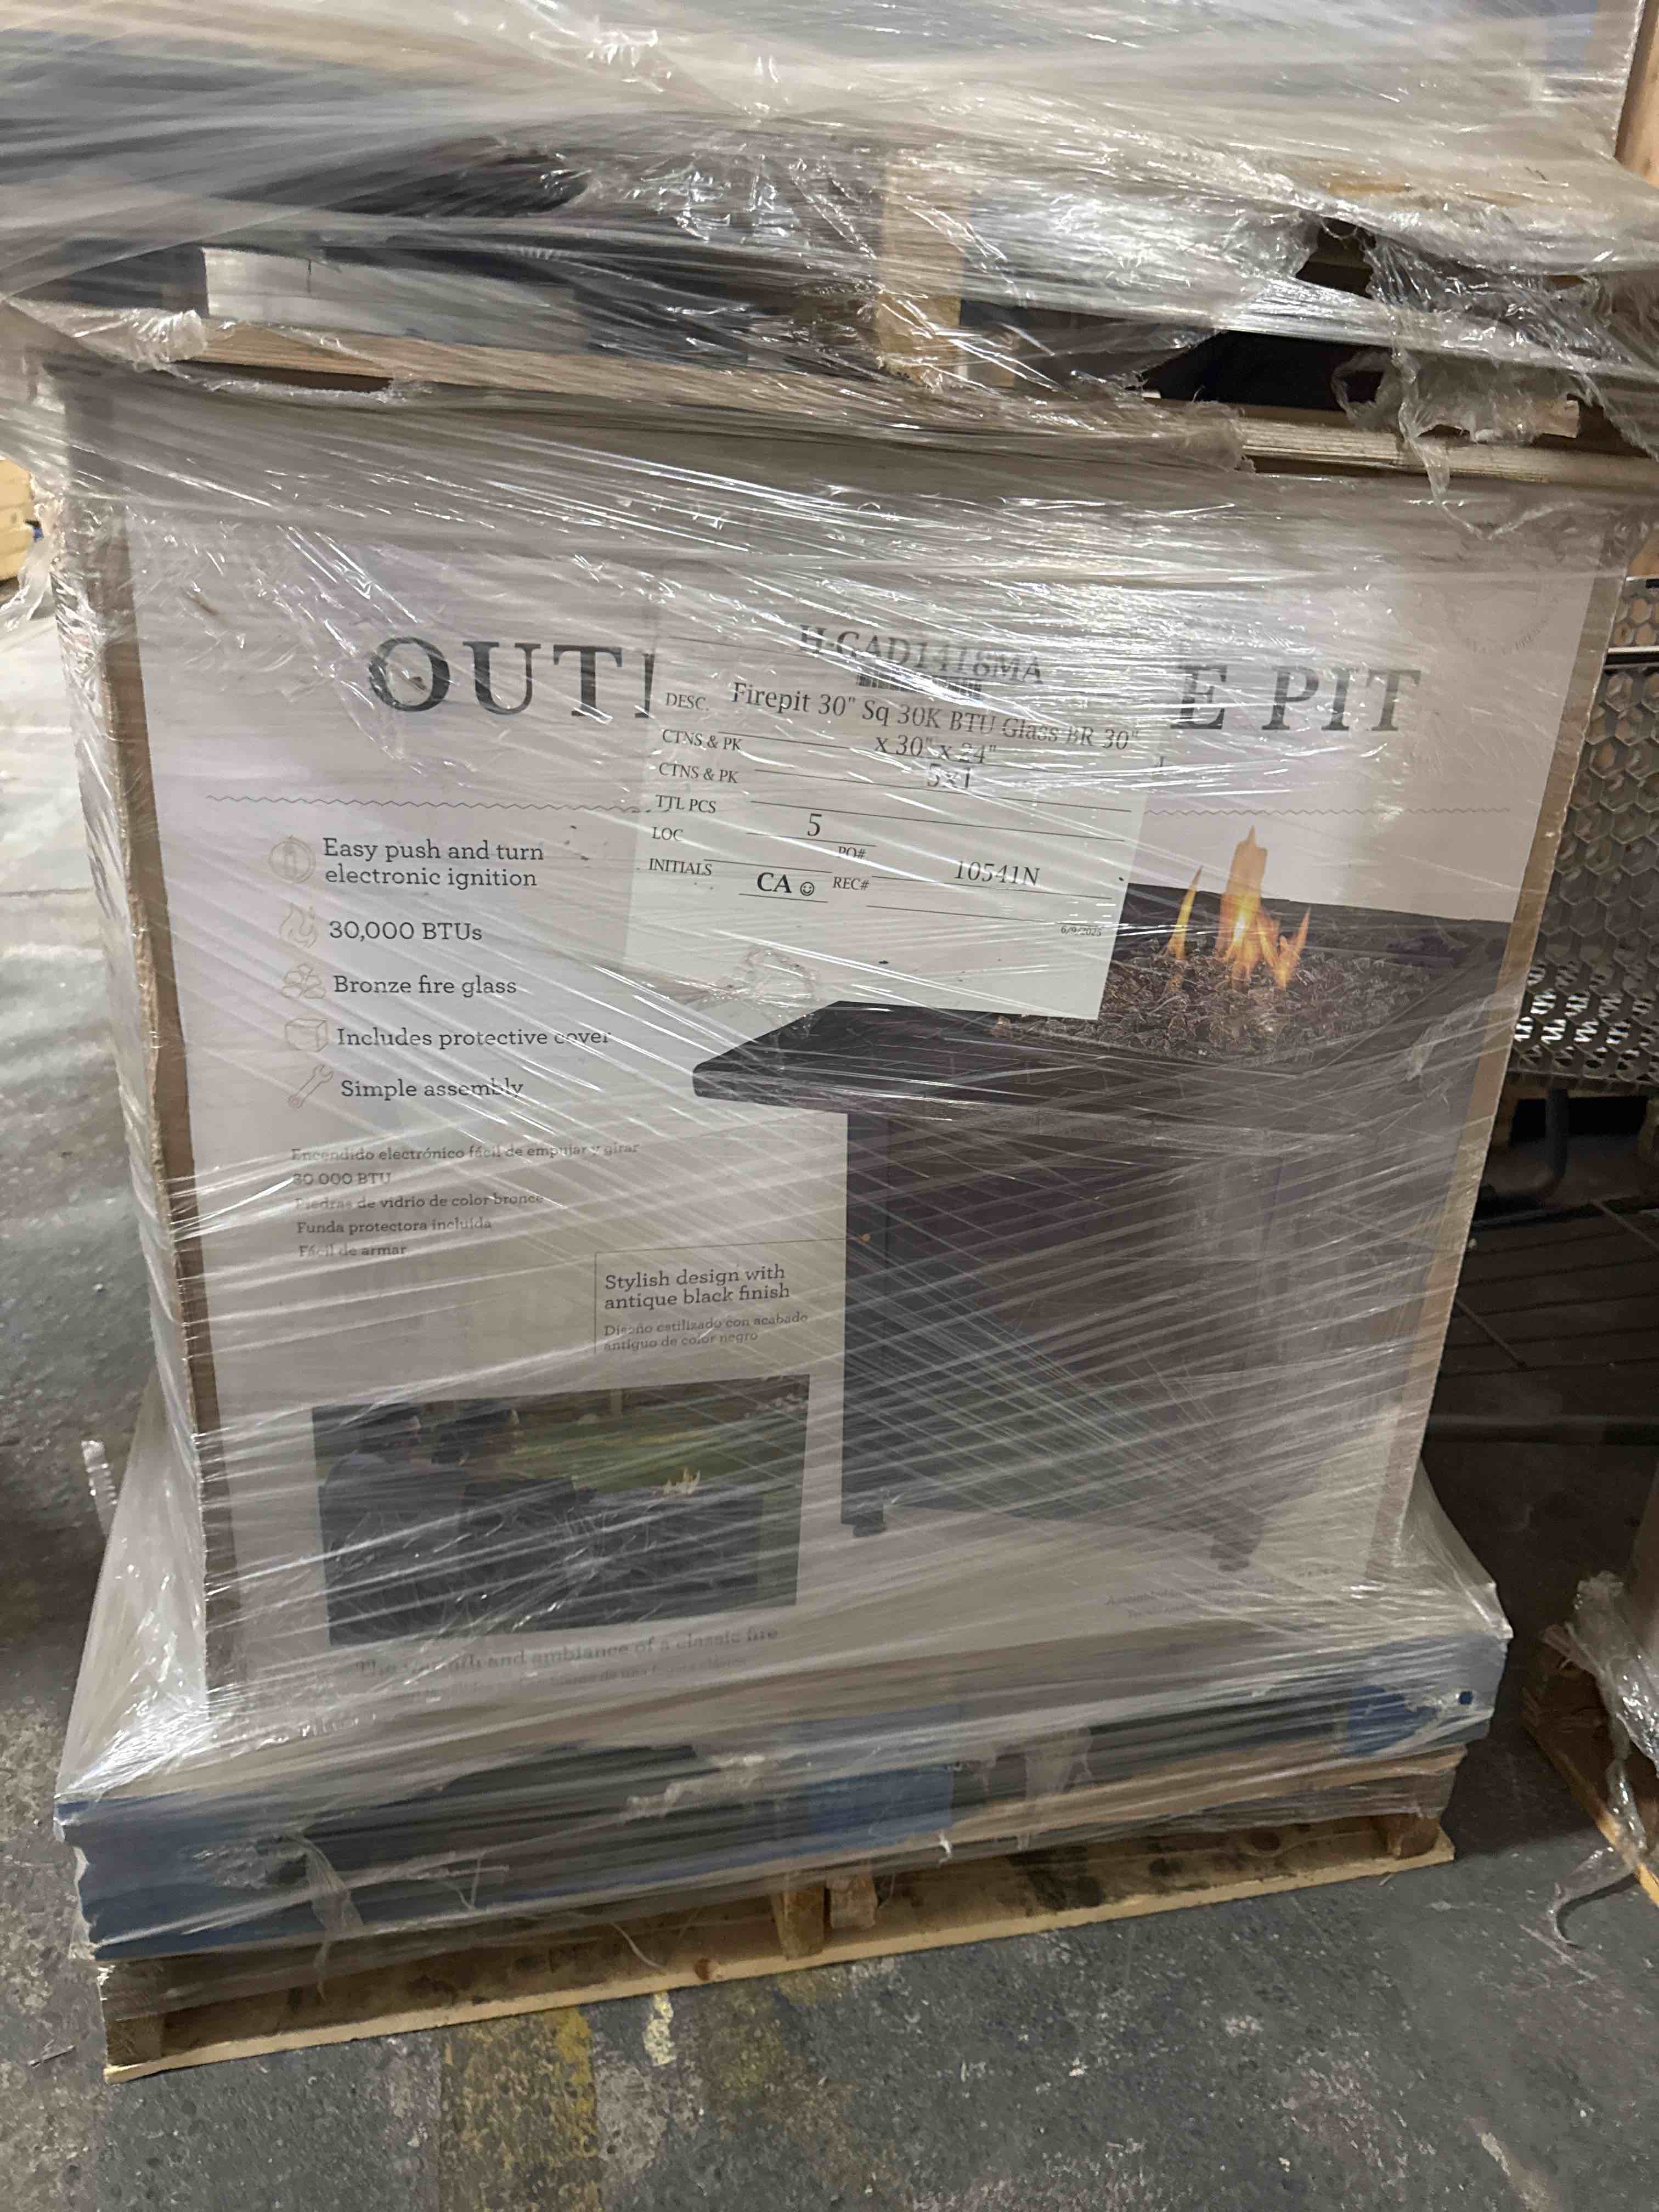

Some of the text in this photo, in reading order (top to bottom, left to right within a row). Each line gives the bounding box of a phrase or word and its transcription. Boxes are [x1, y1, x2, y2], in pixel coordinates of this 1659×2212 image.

[1262, 665, 1421, 732] PIT
[666, 692, 709, 712] DESC.
[732, 682, 811, 714] Firepit
[819, 693, 855, 715] 30"
[862, 700, 889, 727] Sq
[897, 705, 942, 729] 30K
[950, 710, 997, 735] BTU
[1001, 718, 1059, 743] Glass
[1102, 728, 1140, 751] 30"
[662, 729, 742, 751] CTNS & PK
[896, 736, 933, 757] 30"
[658, 761, 738, 783] CTNS & PK
[655, 794, 822, 837] TTL PCS 5
[652, 826, 684, 841] LOC
[323, 838, 544, 862] Easy push and turn
[325, 863, 538, 890] electronic ignition
[648, 857, 870, 894] INITIALS CA REC#
[953, 860, 1041, 887] 10541N
[329, 921, 483, 942] 30,000 BTUs
[333, 974, 517, 998] Bronze fire glass
[337, 1028, 612, 1049] Includes protective cover
[341, 1077, 524, 1101] Simple assembly
[291, 1148, 374, 1161] Encendido
[379, 1147, 465, 1160] electrónico
[469, 1144, 501, 1158] fácil
[505, 1145, 523, 1158] de
[605, 1142, 641, 1156] girar
[319, 1172, 353, 1185] 000
[357, 1172, 391, 1184] BTU
[358, 1195, 376, 1209] de
[380, 1195, 426, 1207] vidrio
[430, 1194, 447, 1207] de
[452, 1193, 490, 1206] color
[494, 1192, 544, 1205] bronce
[297, 1220, 344, 1233] Funda
[349, 1220, 427, 1235] protectora
[361, 1246, 407, 1256] armar
[605, 1263, 786, 1292] Stylish design with
[605, 1282, 791, 1312] antique black finish
[656, 1317, 723, 1333] estilizado
[725, 1318, 750, 1328] con
[753, 1311, 808, 1325] acabado
[661, 1334, 678, 1347] de
[681, 1333, 715, 1345] color
[719, 1331, 758, 1344] negro
